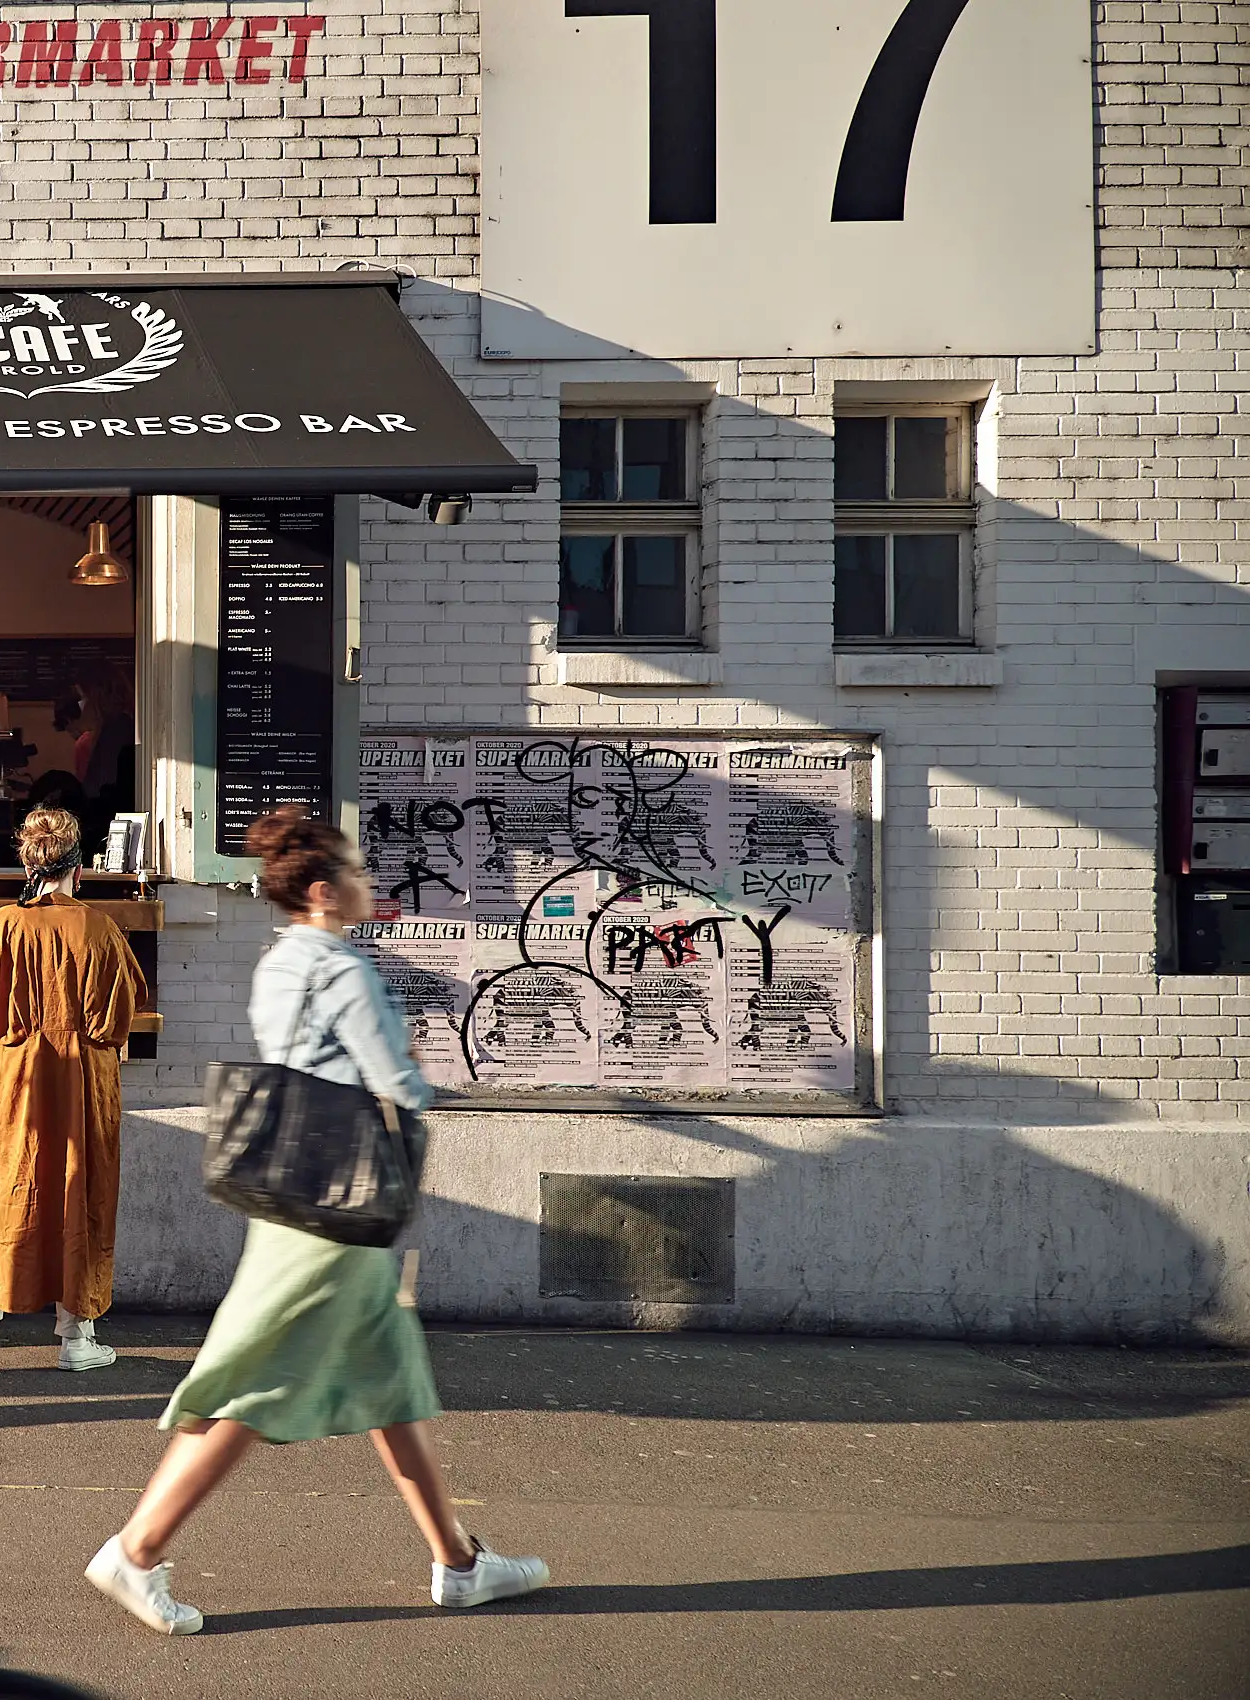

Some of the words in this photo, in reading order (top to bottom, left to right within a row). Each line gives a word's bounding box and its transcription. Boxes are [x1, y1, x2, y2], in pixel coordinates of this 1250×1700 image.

[5, 413, 281, 439] ESPRESSO
[299, 412, 418, 435] BAR
[371, 797, 507, 840] NOT
[352, 923, 465, 939] SUPERMARKET
